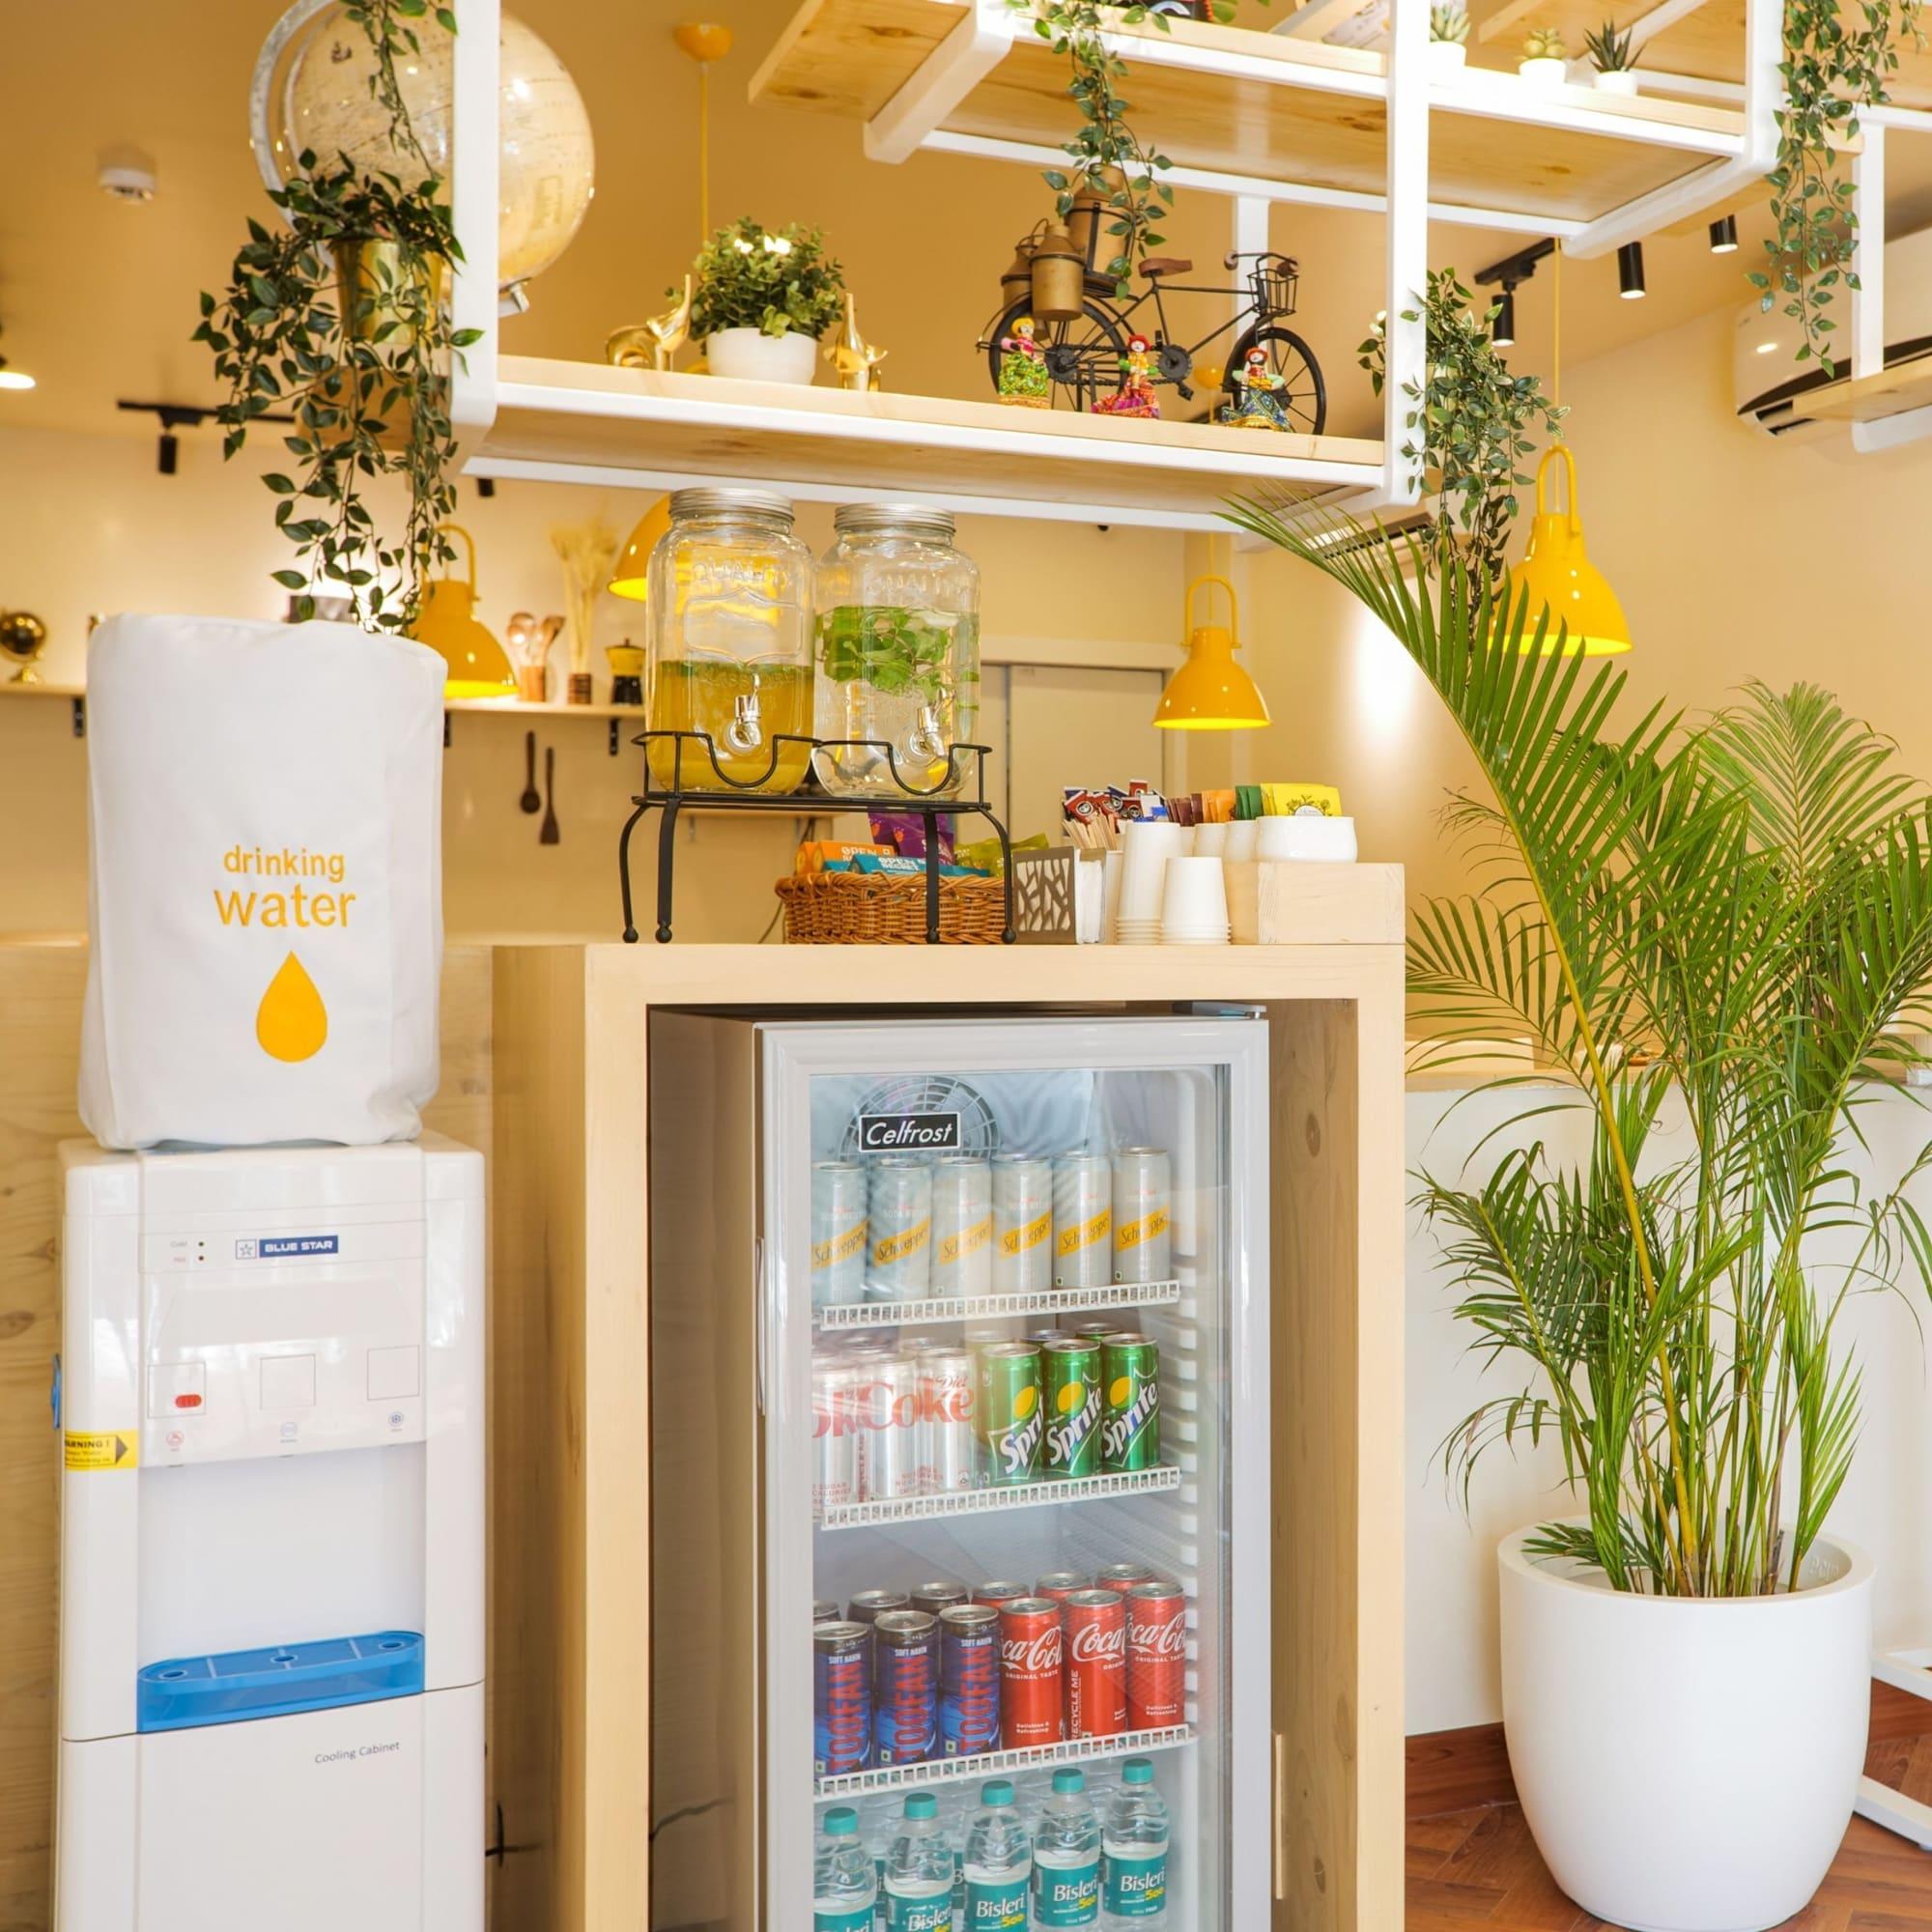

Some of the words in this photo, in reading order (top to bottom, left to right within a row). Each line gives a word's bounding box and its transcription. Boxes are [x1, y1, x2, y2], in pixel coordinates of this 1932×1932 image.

[223, 844, 345, 883] drinking
[213, 883, 356, 927] water
[866, 1120, 952, 1145] Celfrost
[265, 1242, 298, 1253] BLUE
[301, 1240, 333, 1250] STAR
[1102, 1382, 1158, 1459] Sprite
[1039, 1669, 1059, 1678] TASTE
[1070, 1669, 1079, 1689] ME
[894, 1655, 929, 1763] TOOFAN
[958, 1645, 994, 1751] TOOFAN
[828, 1662, 863, 1775] TOOFAN
[1070, 1690, 1079, 1740] RECYCLE
[314, 1749, 356, 1764] Cooling
[358, 1742, 400, 1756] Cabinet
[1053, 1874, 1097, 1902] Bisleri
[1120, 1866, 1165, 1892] Bisleri
[976, 1892, 1025, 1918] Bisleri
